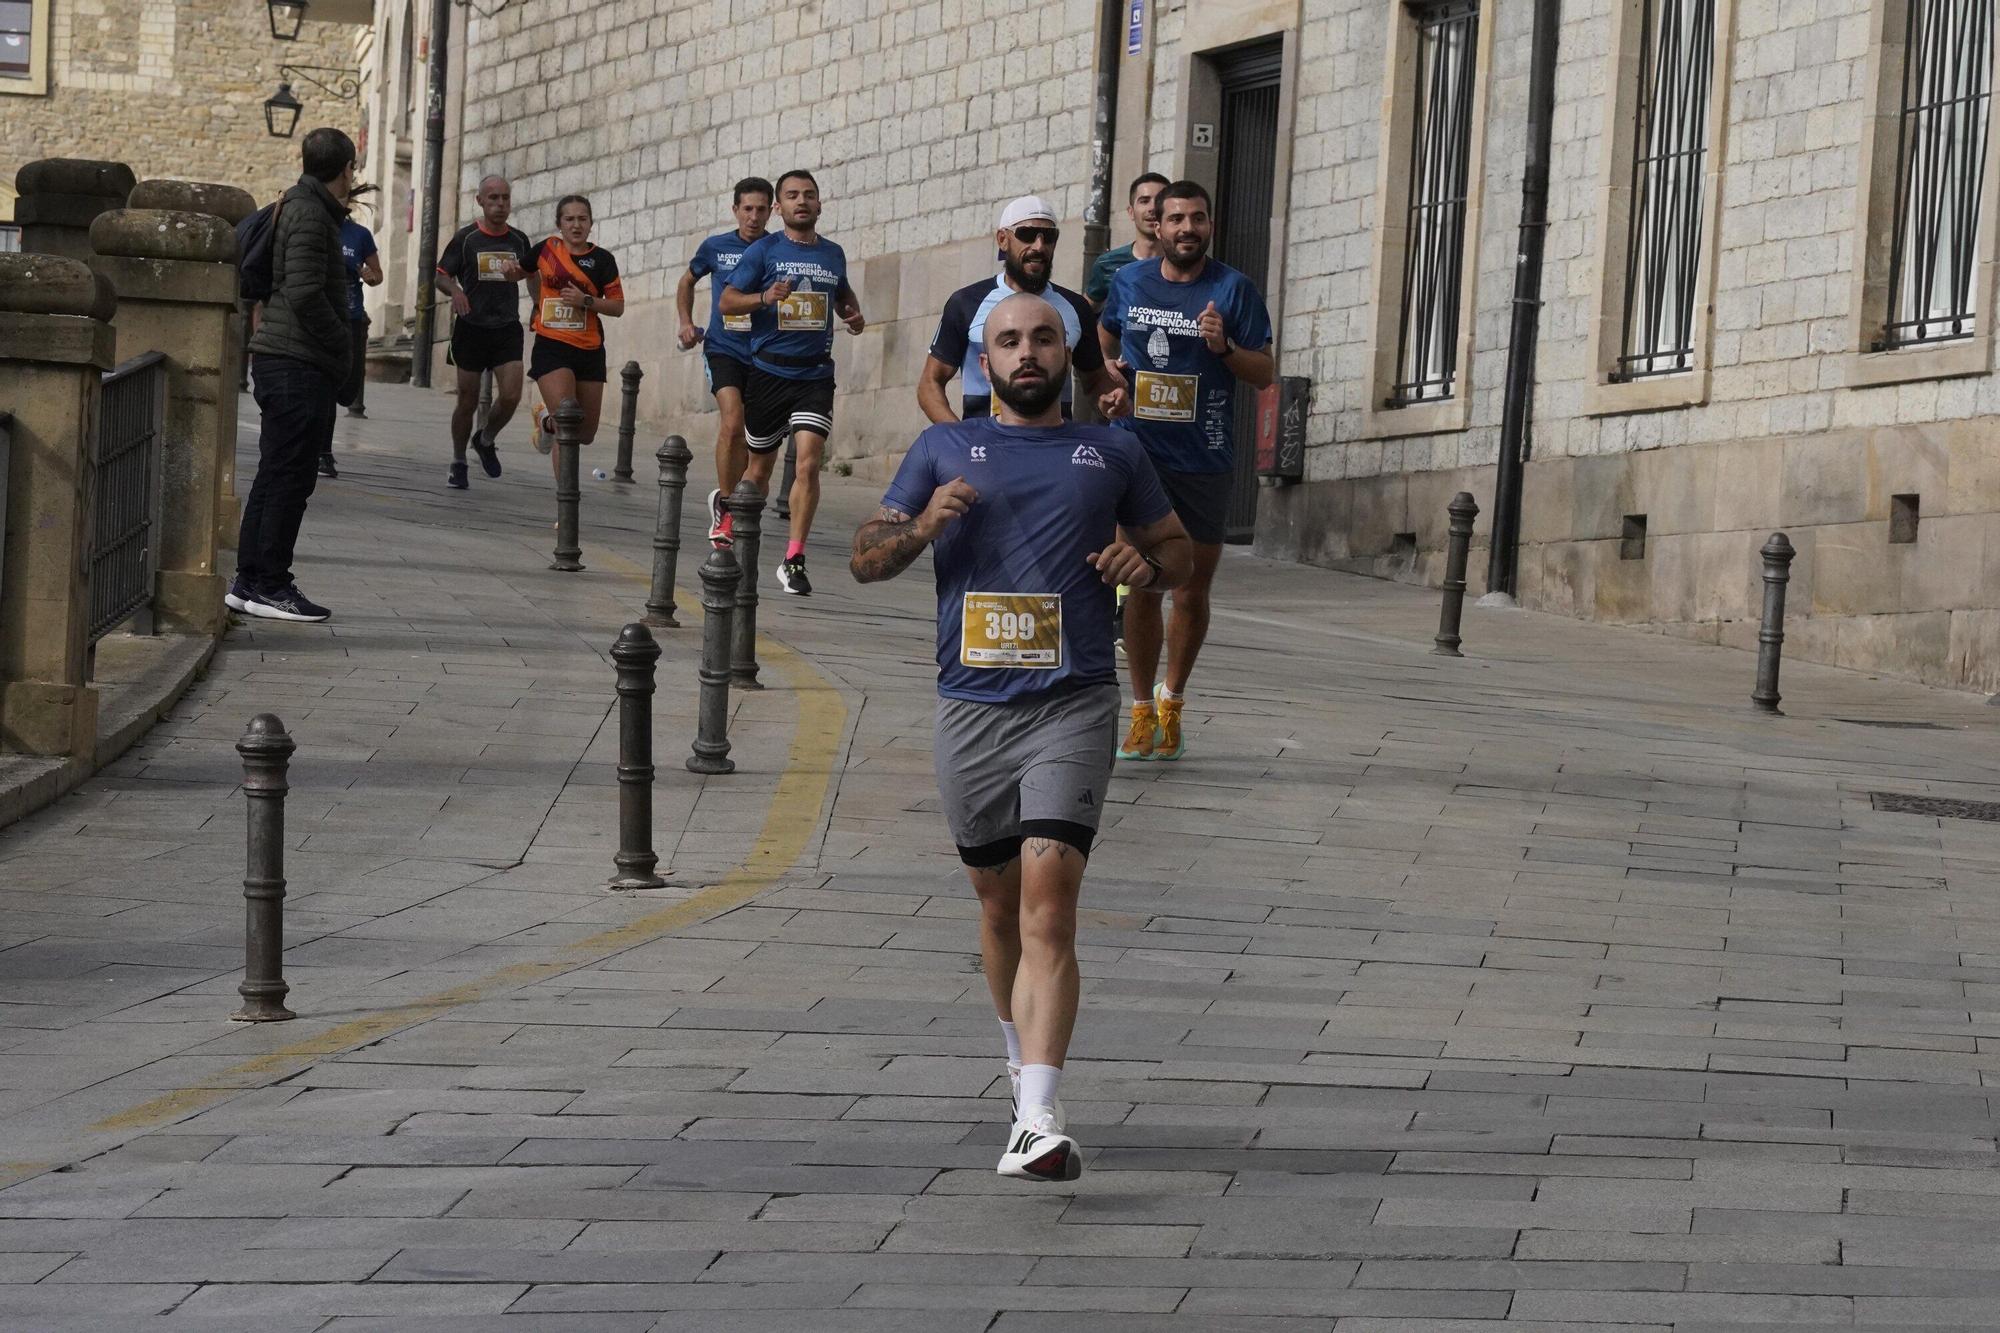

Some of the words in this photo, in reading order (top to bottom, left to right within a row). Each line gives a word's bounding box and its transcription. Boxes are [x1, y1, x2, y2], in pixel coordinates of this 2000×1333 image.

[787, 268, 833, 278] ALMENDRA
[554, 306, 574, 319] 577
[796, 301, 812, 316] 79
[1137, 307, 1183, 319] CONQUISTA
[1137, 314, 1198, 330] ALMENDRA
[1168, 327, 1201, 337] KONKIST
[1150, 384, 1179, 404] 574
[1071, 458, 1106, 469] MADEN
[985, 612, 1035, 640] 399
